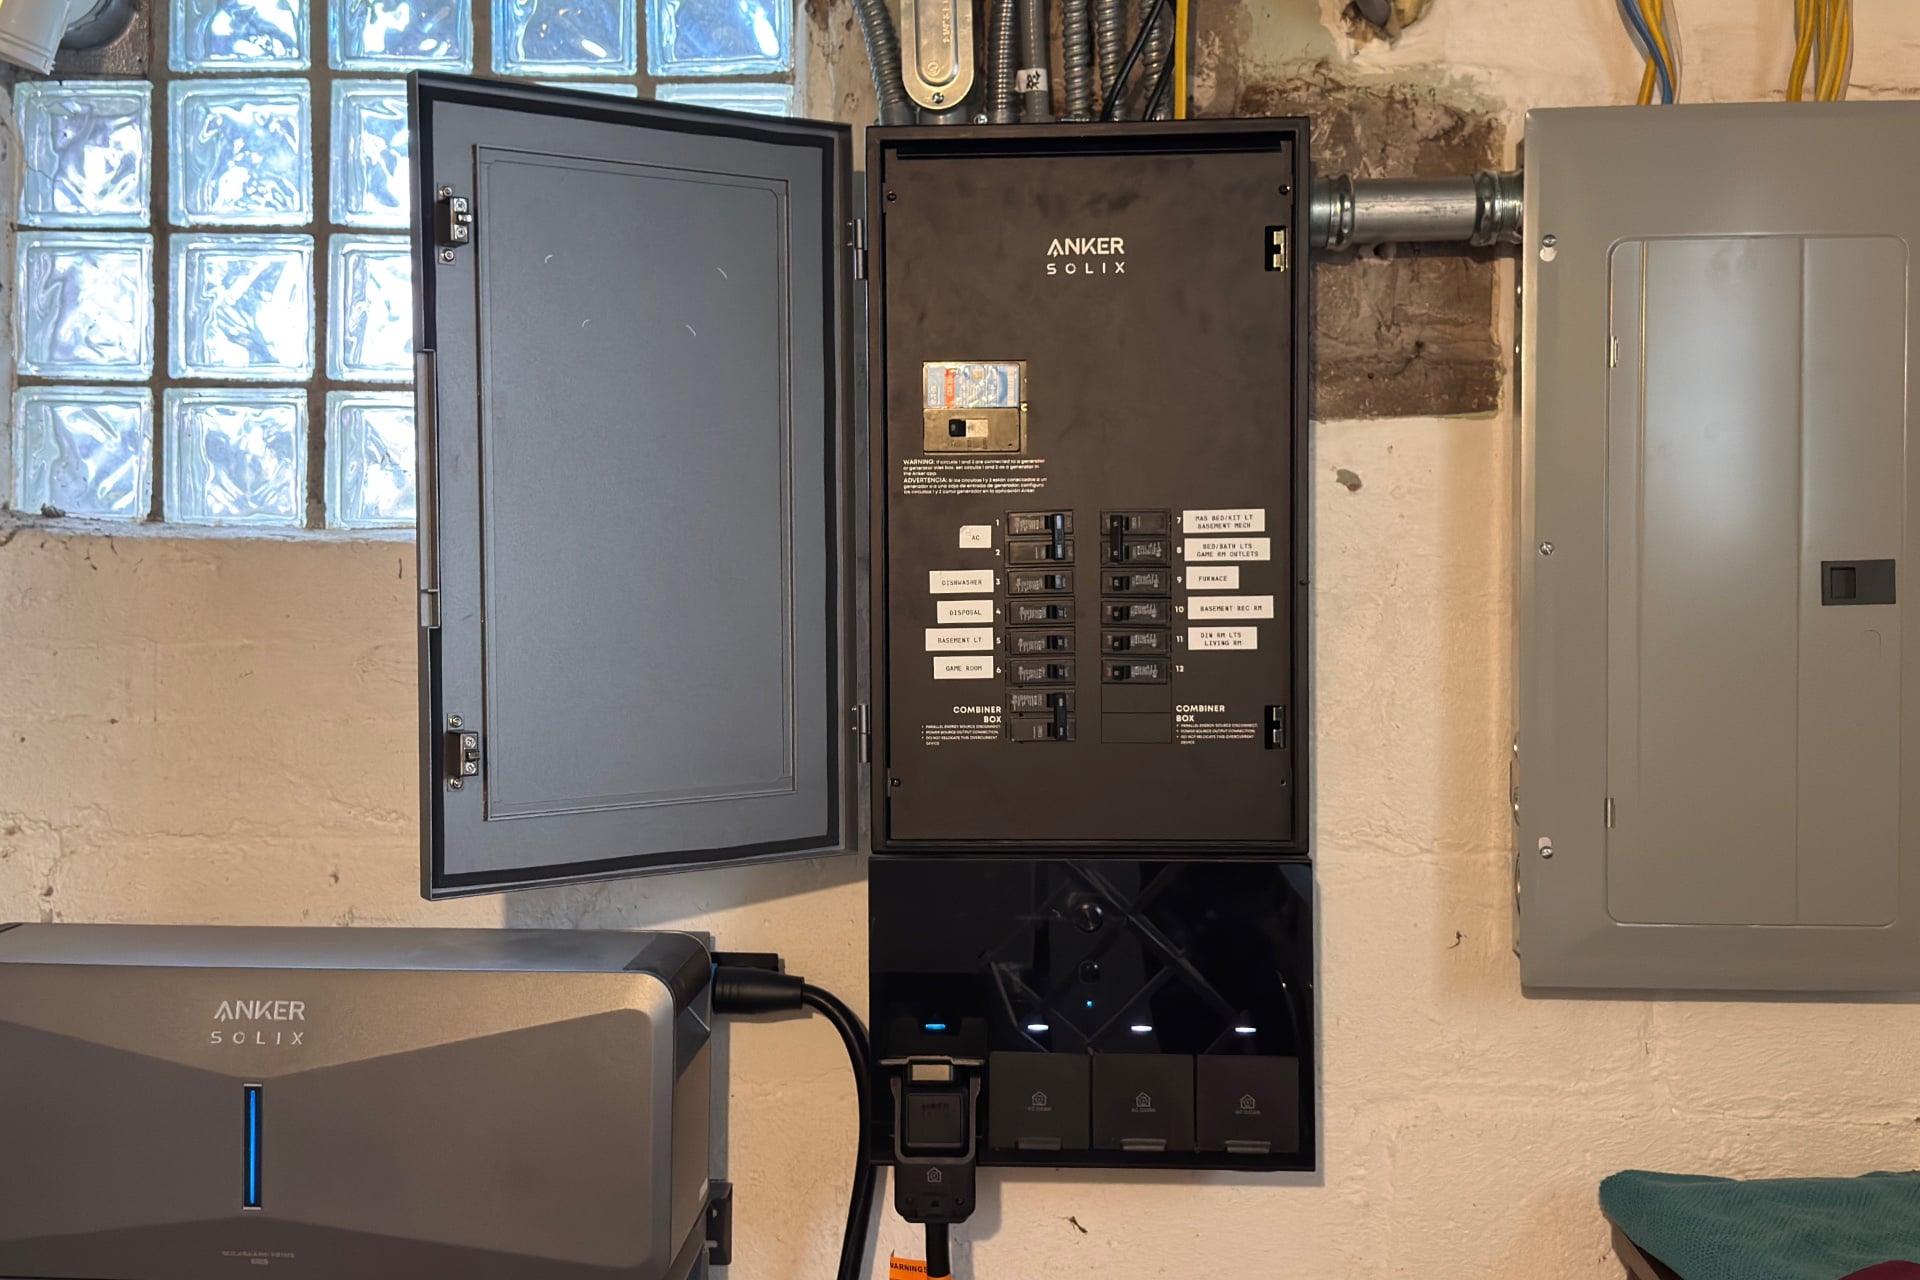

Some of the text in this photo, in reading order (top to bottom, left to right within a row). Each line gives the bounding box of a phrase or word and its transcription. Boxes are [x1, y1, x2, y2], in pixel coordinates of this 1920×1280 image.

[1046, 237, 1125, 257] ANKER
[1046, 262, 1125, 274] SOLIX
[214, 1000, 305, 1021] ANKER
[210, 1031, 304, 1045] SOLIX
